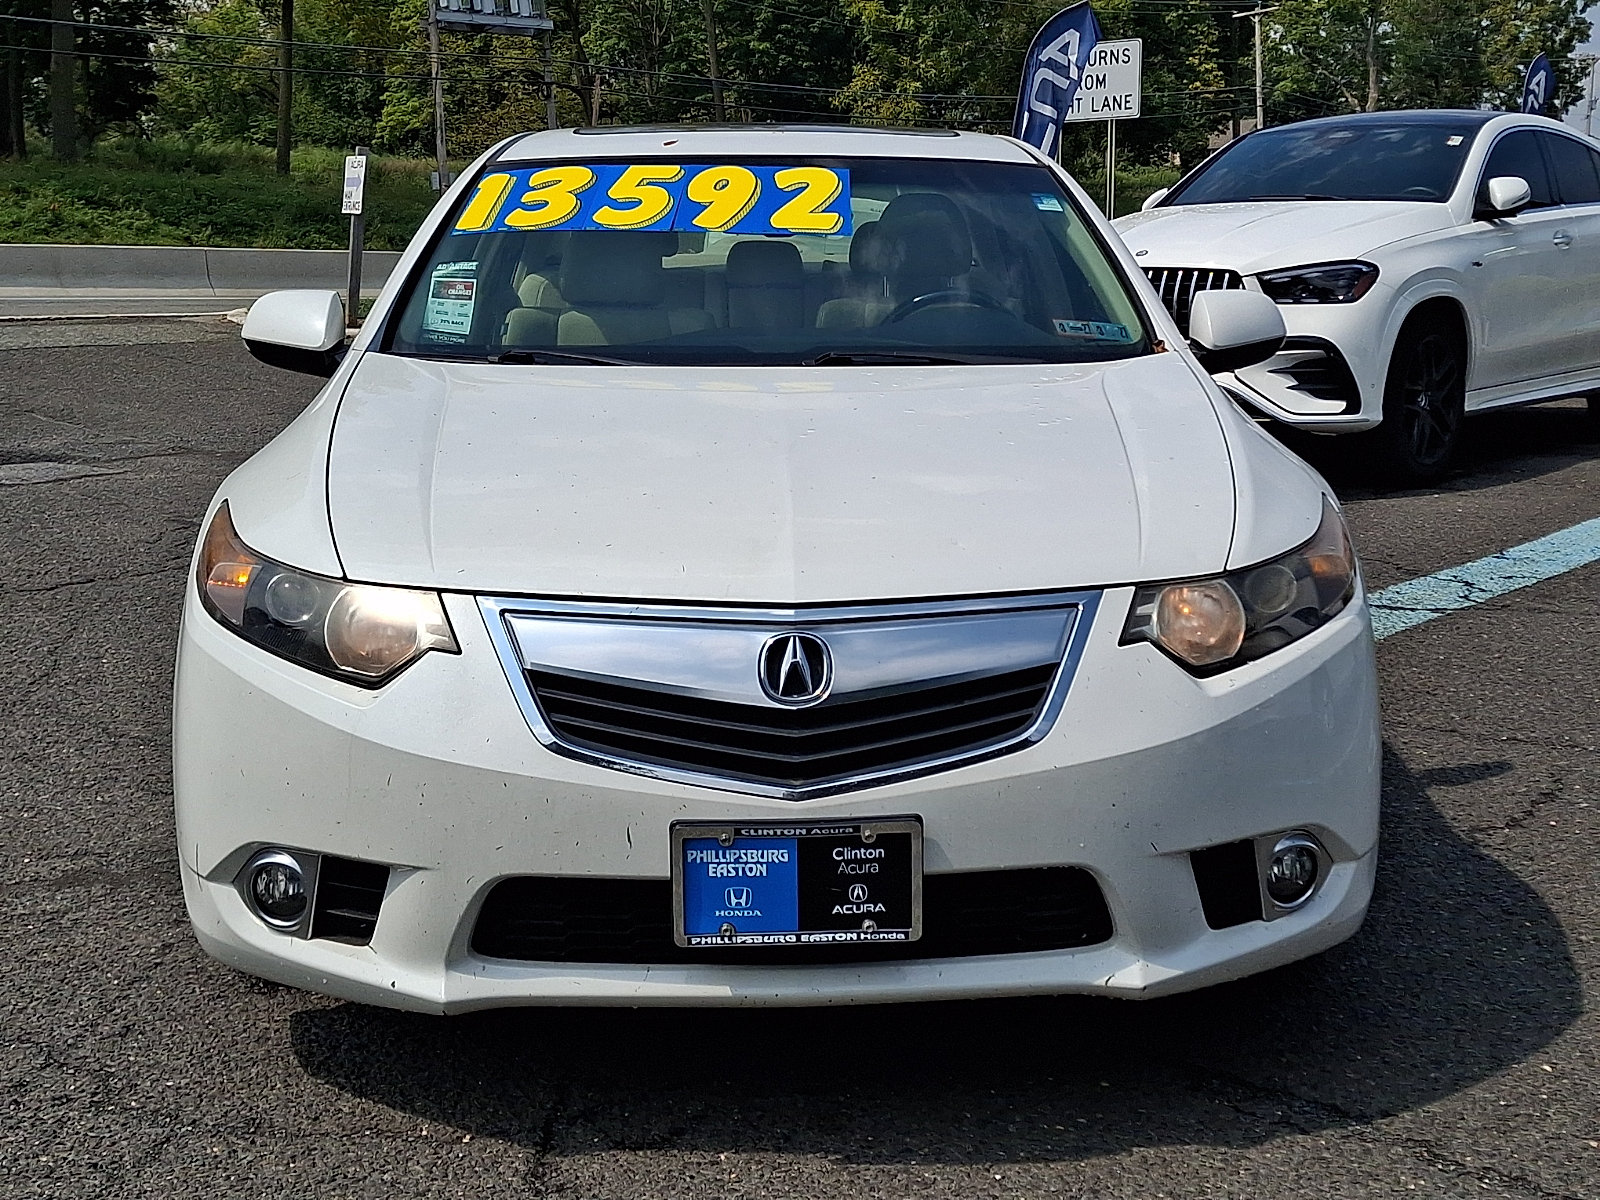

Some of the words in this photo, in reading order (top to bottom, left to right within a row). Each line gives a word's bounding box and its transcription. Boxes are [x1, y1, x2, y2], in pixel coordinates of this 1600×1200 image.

[1088, 48, 1131, 67] URNS
[1080, 73, 1107, 90] OM
[1091, 94, 1133, 113] LANE
[455, 165, 843, 233] 13592
[741, 828, 807, 836] CLINTON
[811, 827, 853, 835] Acura
[687, 850, 789, 863] PHILLIPSBURG
[832, 847, 885, 861] Clinton
[708, 864, 767, 878] EASTON
[837, 862, 879, 875] Acura
[715, 910, 763, 918] HONDA
[832, 903, 886, 914] ACURA
[691, 934, 797, 945] PHILLIPSBURG
[801, 932, 857, 943] EASTON
[860, 932, 905, 941] Honda
